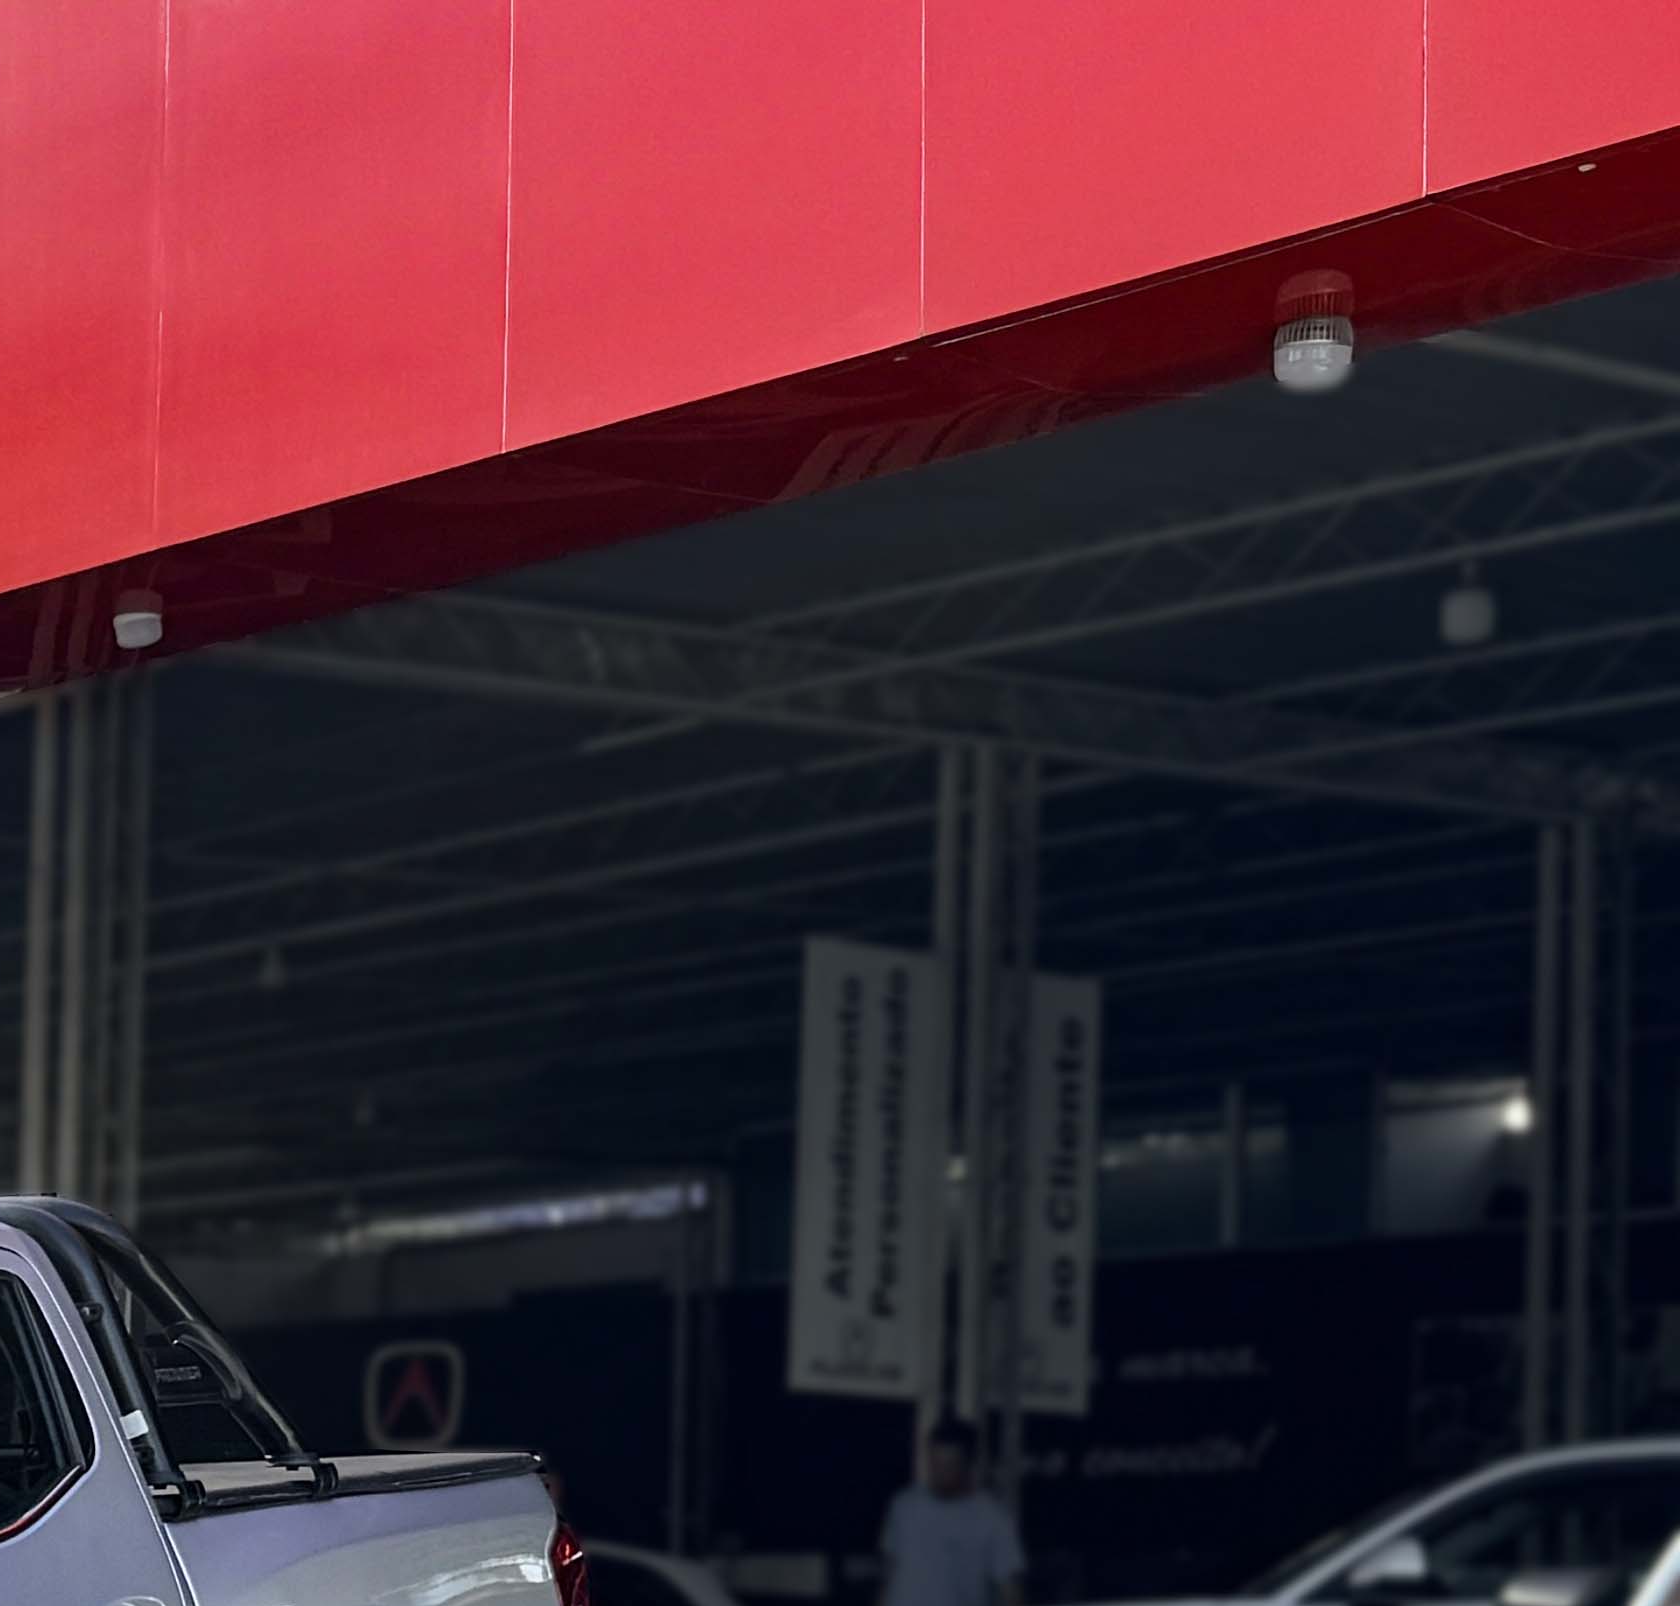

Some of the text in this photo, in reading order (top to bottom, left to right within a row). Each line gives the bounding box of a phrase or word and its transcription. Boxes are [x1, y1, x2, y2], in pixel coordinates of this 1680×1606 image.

[824, 974, 864, 1298] Atendimento
[868, 966, 909, 1319] Personalizado
[1044, 1014, 1087, 1330] ao Cliente
